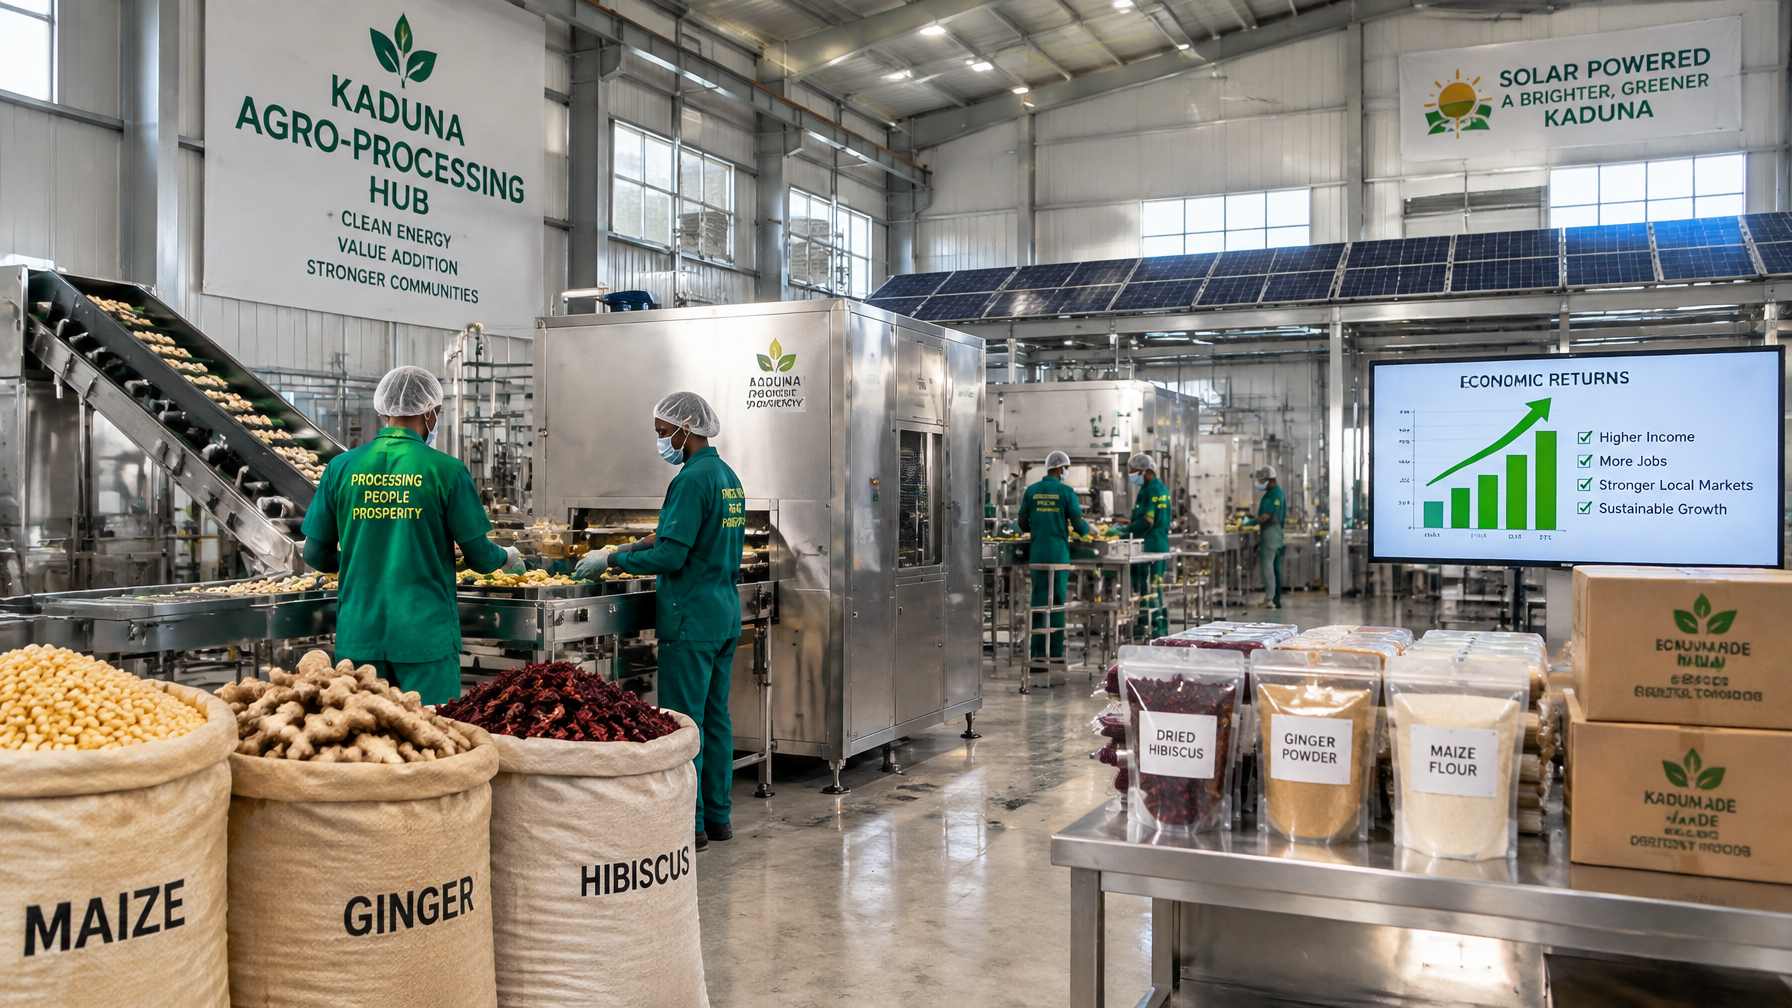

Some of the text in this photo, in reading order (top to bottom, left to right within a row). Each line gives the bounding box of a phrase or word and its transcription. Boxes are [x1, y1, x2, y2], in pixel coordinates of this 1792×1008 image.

[1499, 47, 1711, 88] SOLAR POWERED
[1501, 73, 1709, 108] A BRIGHTER, GREENER
[331, 73, 465, 147] KADUNA
[1544, 100, 1654, 128] KADUNA
[235, 95, 525, 204] AGRO-PROCESSING
[370, 175, 429, 215] HUB
[341, 210, 452, 249] CLEAN ENERGY
[337, 236, 458, 276] VALUE ADDITION
[306, 259, 479, 304] STRONGER COMMUNITIES
[1460, 371, 1629, 388] ECONOMIC RETURNS
[1599, 431, 1695, 446] Higher Income
[1599, 455, 1668, 467] More Jobs
[350, 473, 423, 487] PROCESSING
[1599, 479, 1754, 494] Stronger Local Markets
[364, 490, 410, 504] PEOPLE
[352, 507, 423, 520] PROSPERITY
[1599, 502, 1727, 515] Sustainable Growth
[1156, 729, 1196, 744] DRIED
[1284, 732, 1336, 748] GINGER
[1149, 743, 1204, 760] HIBISCUS
[1282, 748, 1337, 764] POWDER
[1430, 744, 1477, 760] MAIZE
[1429, 761, 1478, 777] FLOUR
[580, 845, 690, 897] HIBISCUS
[343, 875, 475, 937] GINGER
[23, 878, 186, 957] MAIZE
